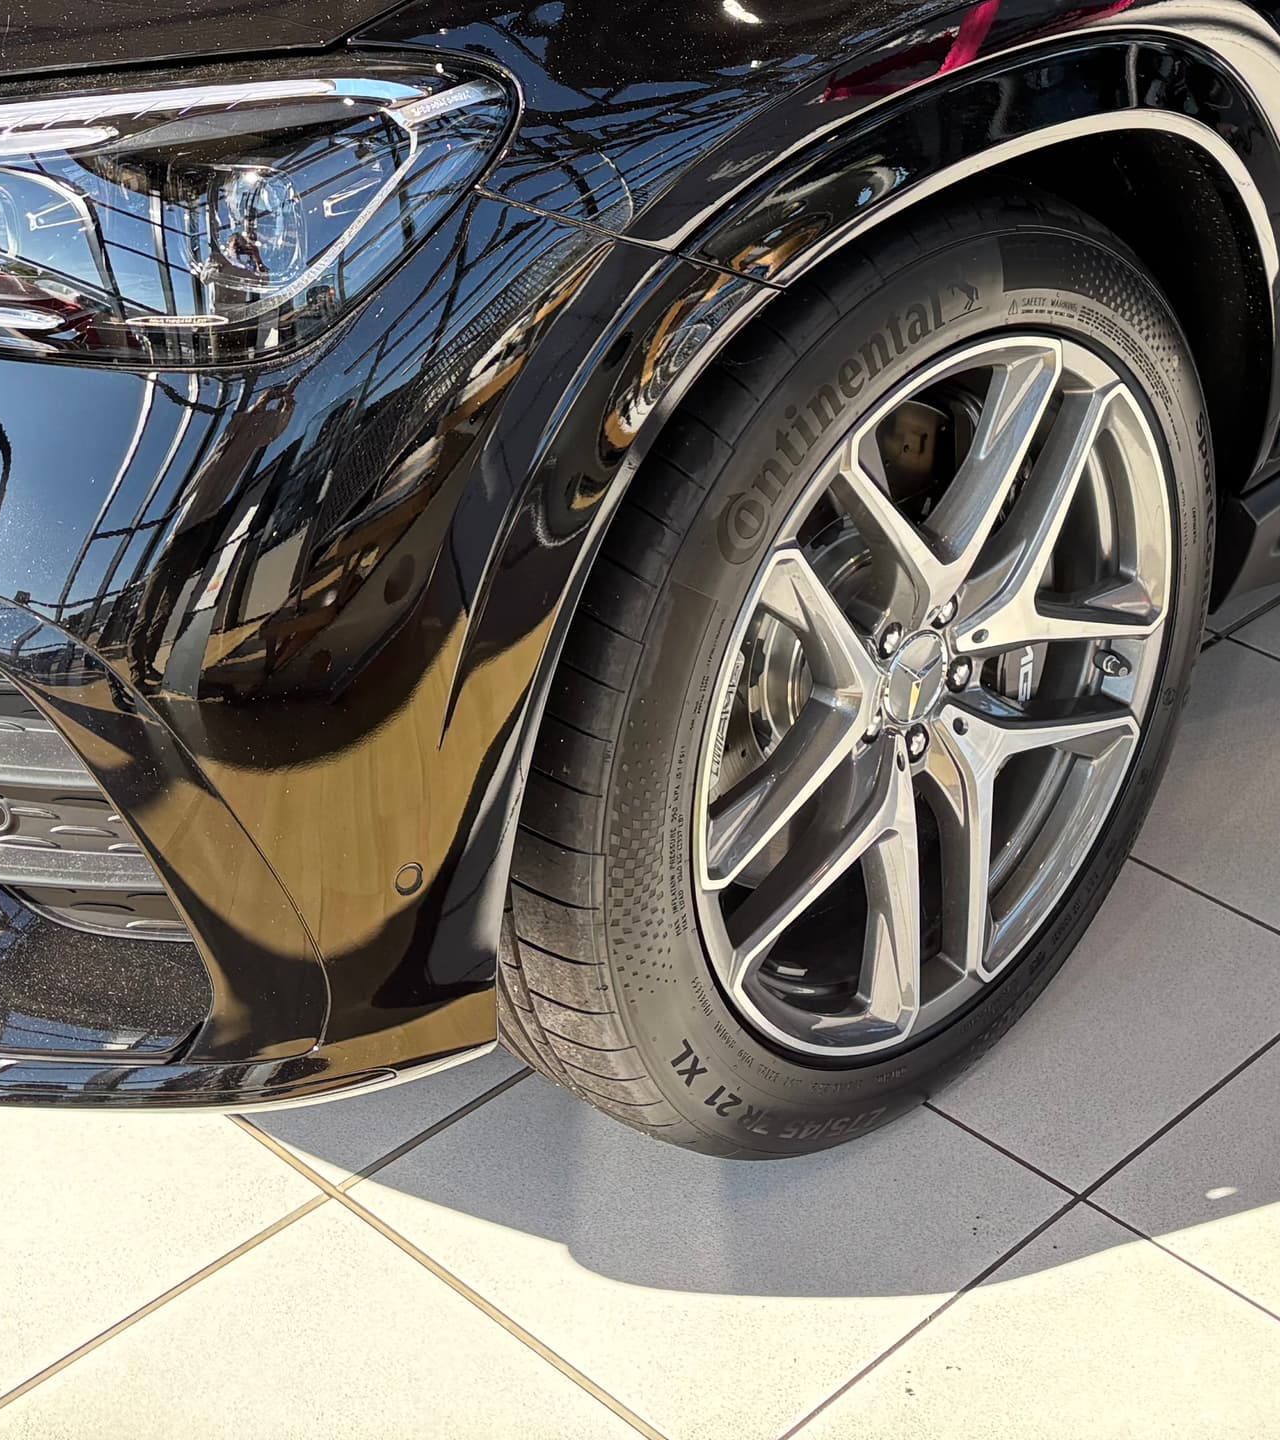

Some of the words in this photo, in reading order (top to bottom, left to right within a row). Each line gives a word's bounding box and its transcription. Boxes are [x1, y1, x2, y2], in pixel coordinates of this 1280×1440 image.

[1022, 296, 1047, 307] SAFETY
[717, 285, 946, 564] Continental
[670, 1038, 708, 1088] XL
[703, 1085, 743, 1118] 21
